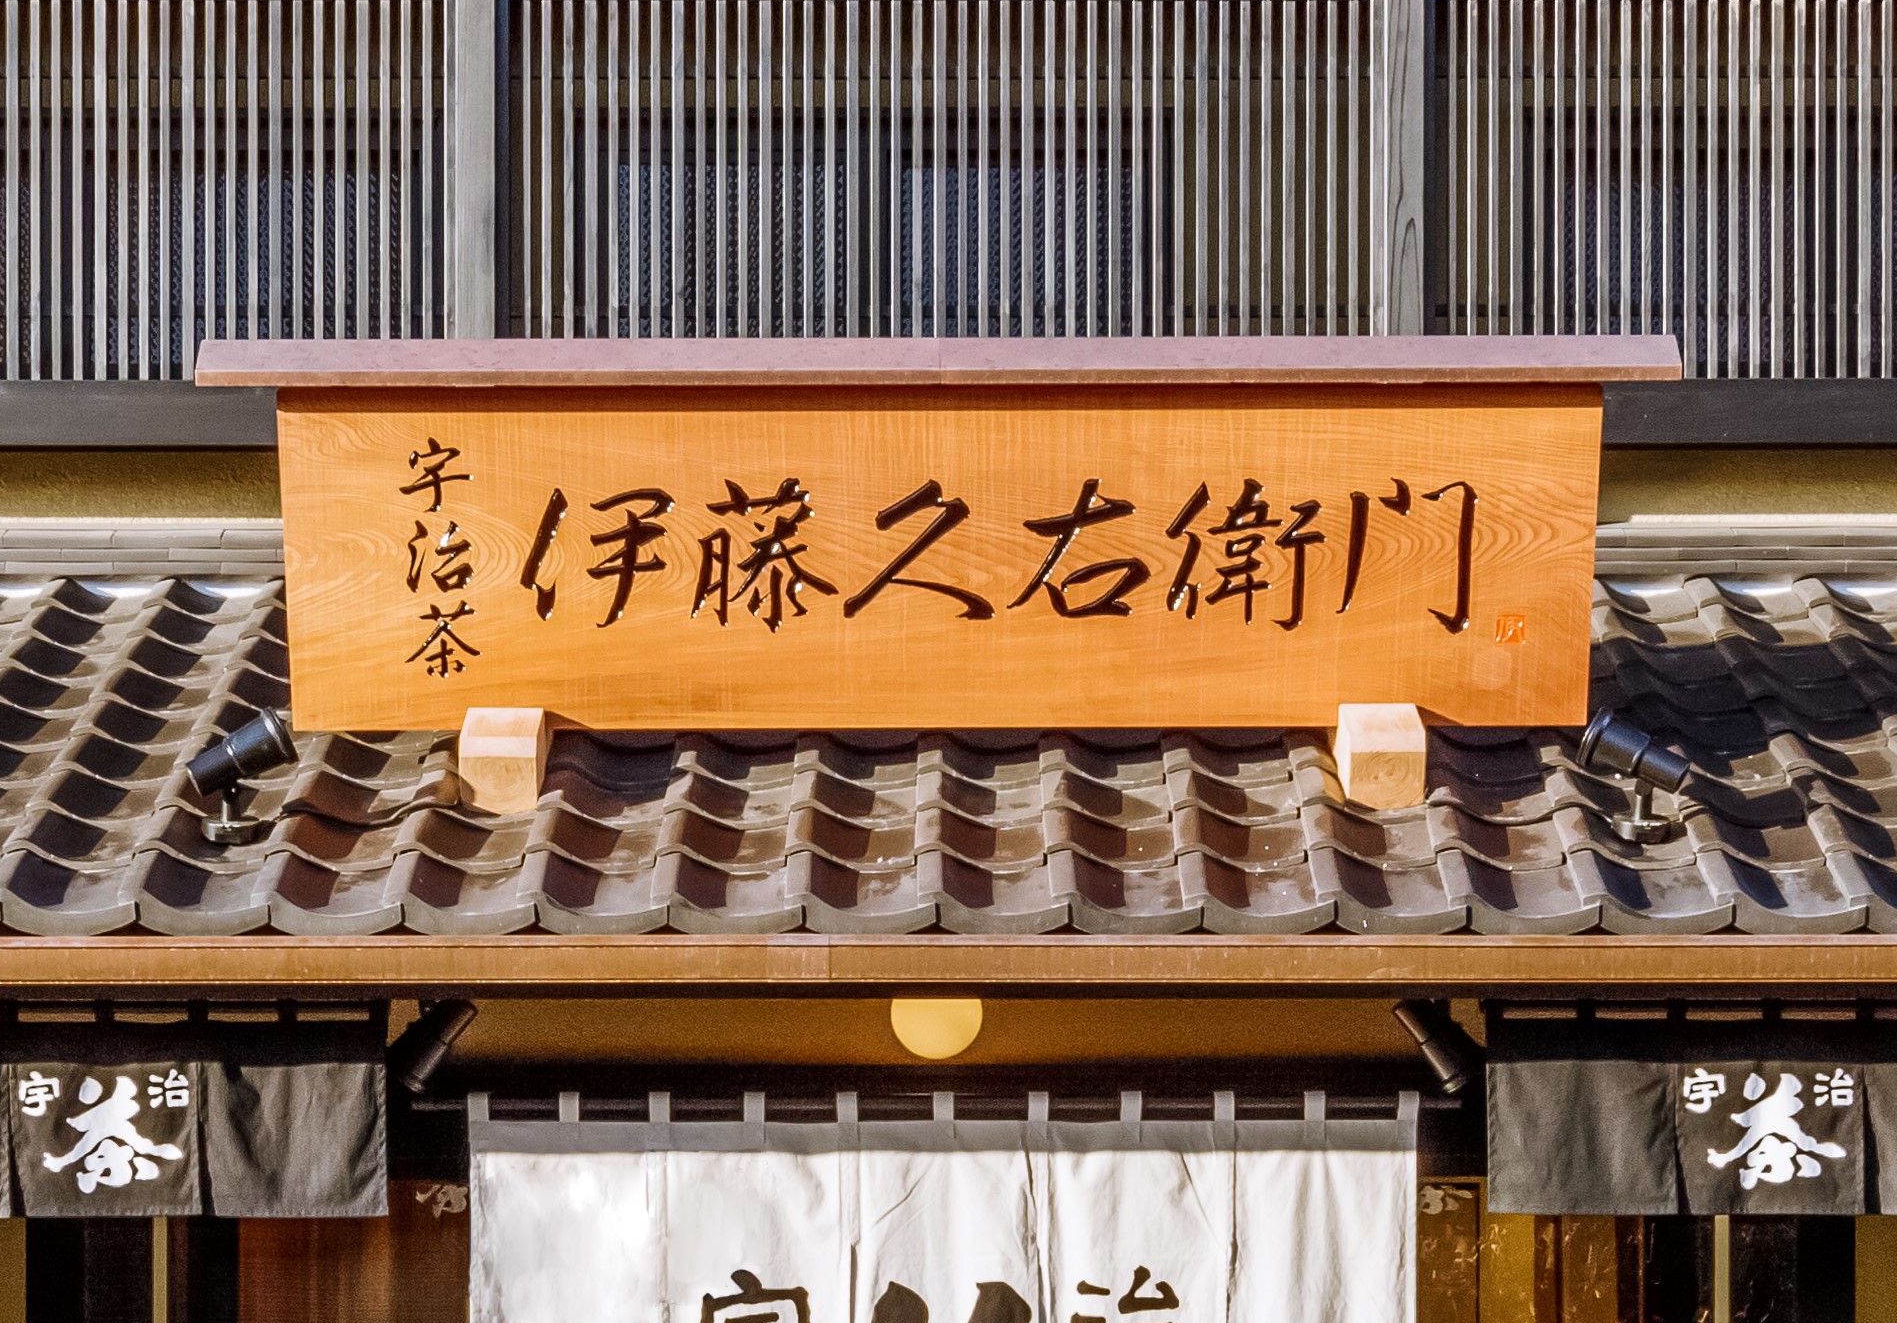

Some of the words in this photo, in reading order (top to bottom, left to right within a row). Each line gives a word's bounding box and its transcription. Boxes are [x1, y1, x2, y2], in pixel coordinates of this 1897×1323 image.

[397, 436, 482, 679] 宇治茶
[519, 476, 1479, 636] 伊藤久右衛門
[41, 1074, 185, 1195] 茶
[1705, 1071, 1848, 1191] 茶
